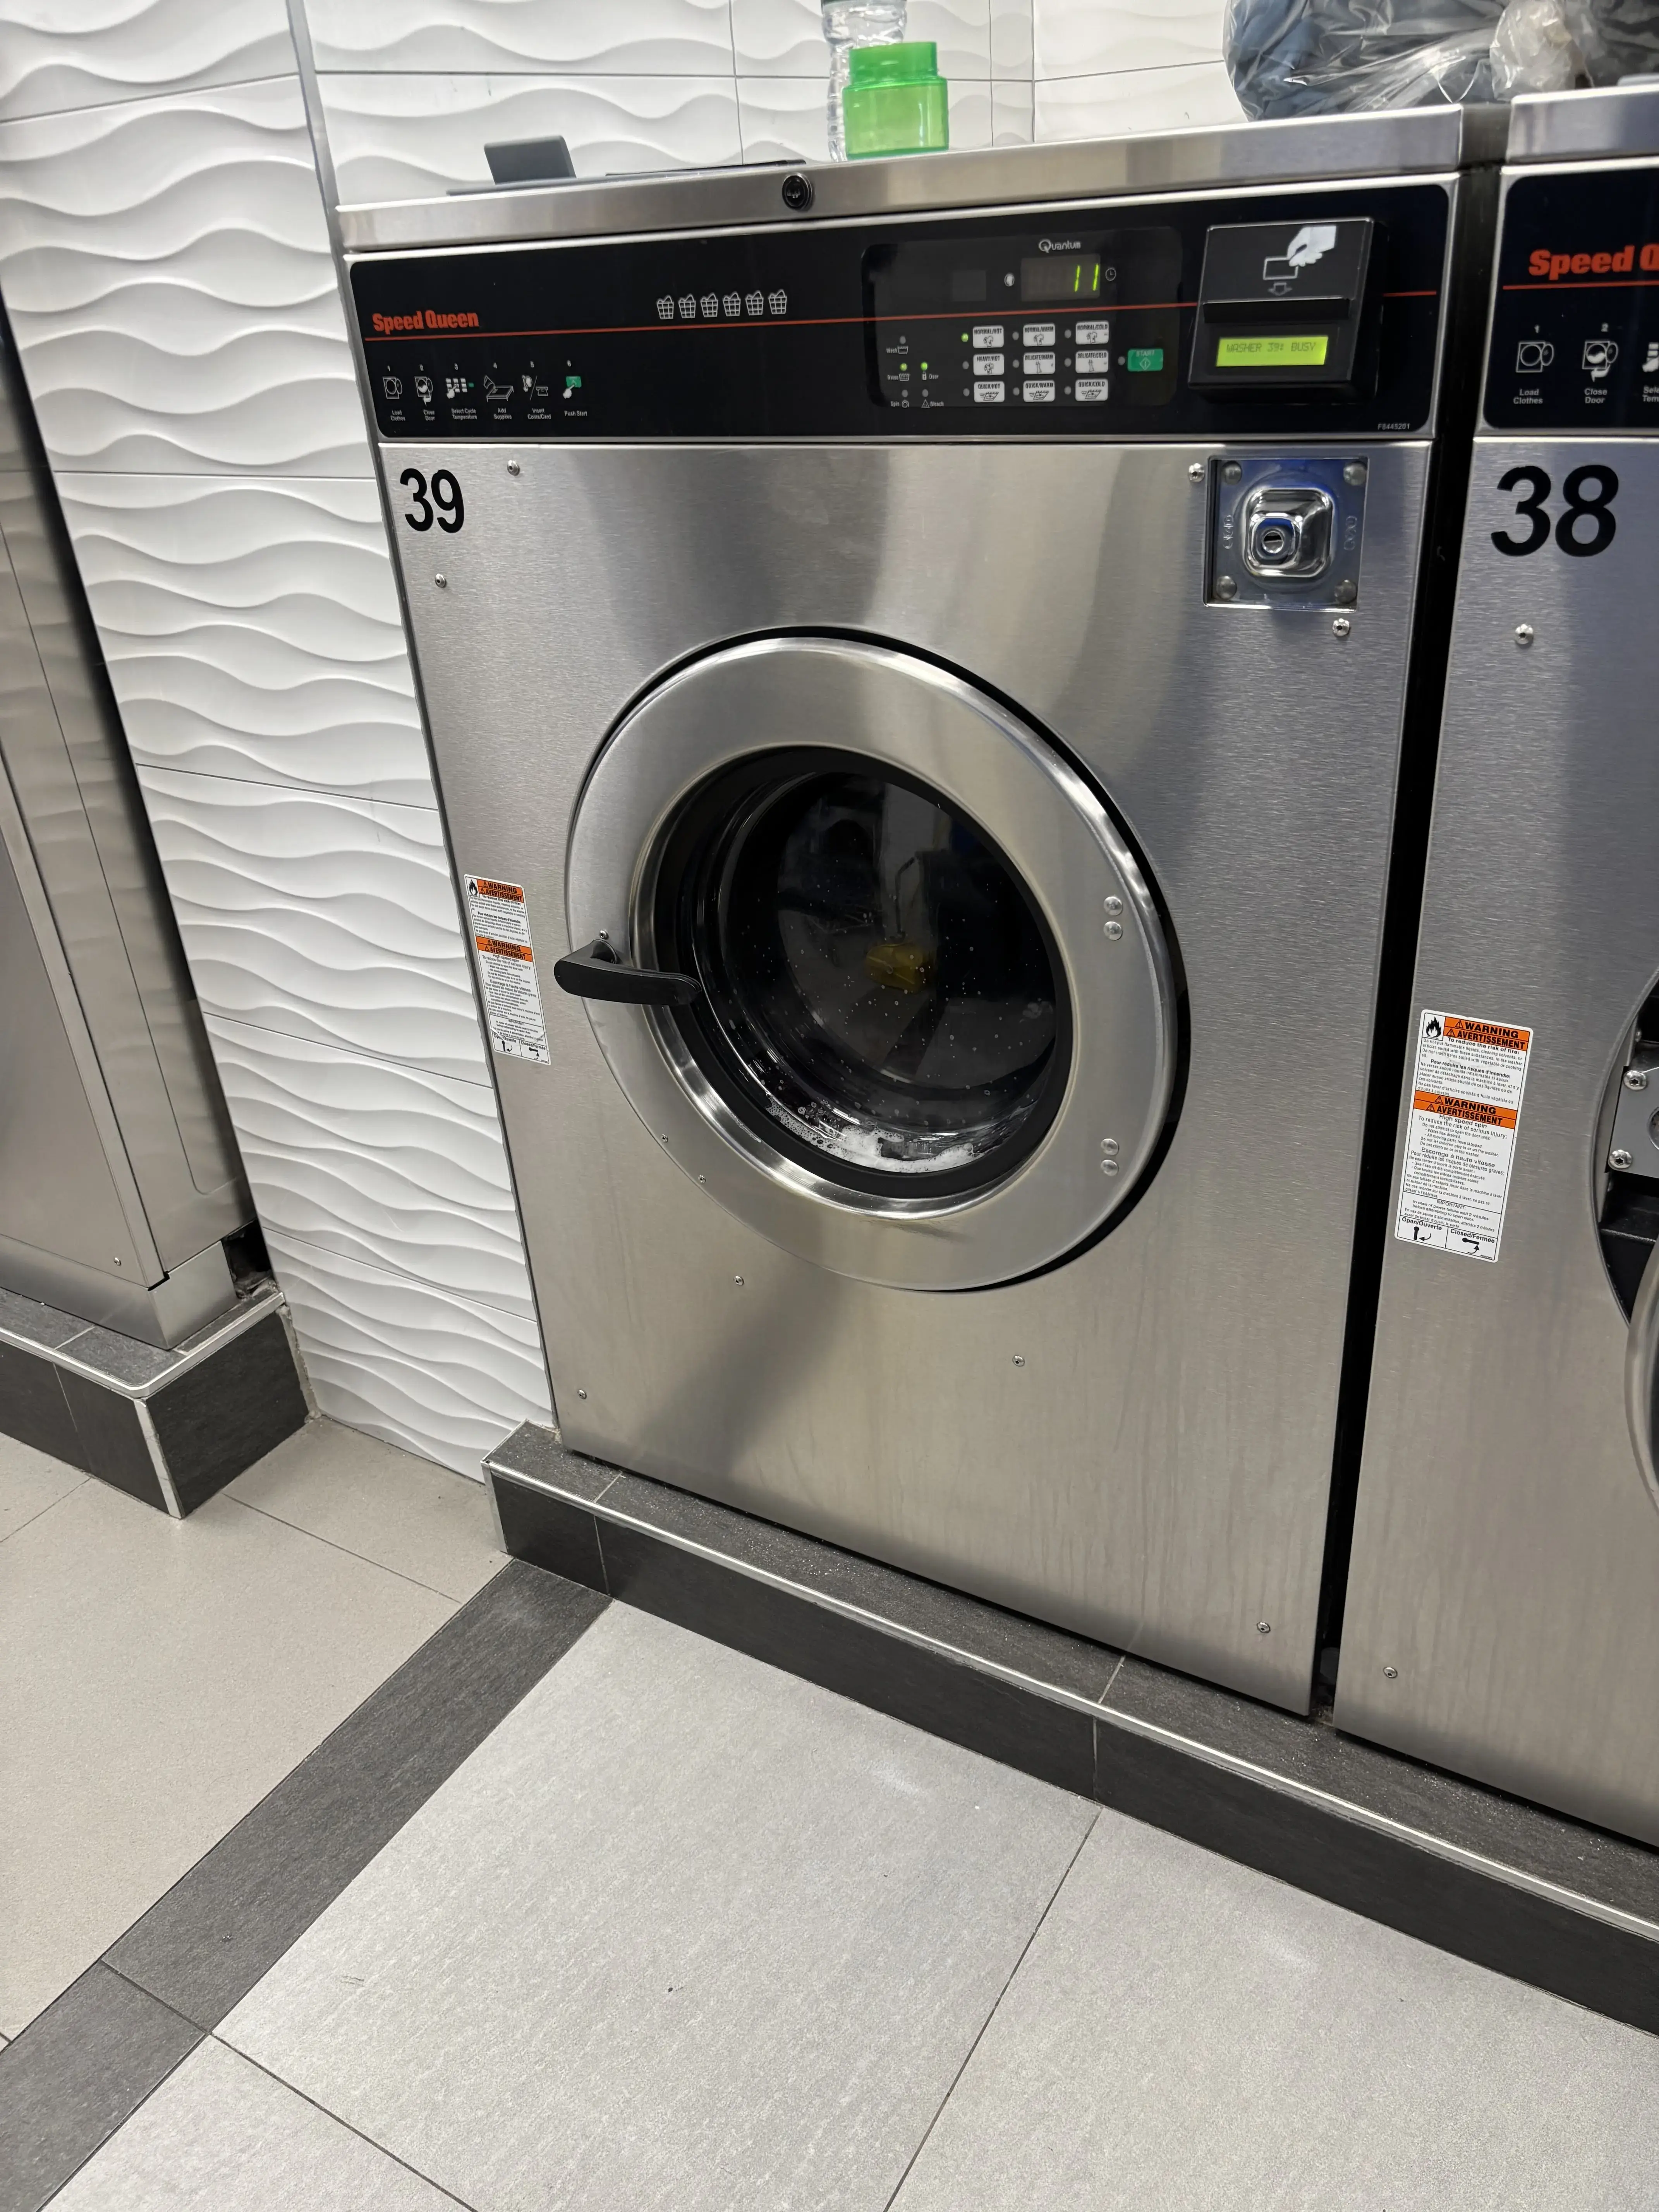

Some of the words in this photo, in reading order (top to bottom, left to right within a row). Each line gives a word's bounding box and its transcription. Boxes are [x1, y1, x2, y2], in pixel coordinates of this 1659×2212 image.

[1038, 239, 1081, 253] Quantum
[1528, 245, 1635, 280] Speed
[1074, 264, 1099, 292] 11
[373, 311, 424, 335] Speed
[425, 310, 479, 328] Queen
[1534, 325, 1540, 333] 1
[1601, 322, 1609, 332] 2
[1226, 343, 1262, 353] WASHER
[1291, 342, 1316, 352] BUSY
[400, 468, 465, 533] 39
[1491, 465, 1619, 558] 38
[485, 888, 522, 902] AVERTISSEMENT
[488, 882, 517, 893] WARNING
[489, 946, 526, 960] AVERTISSEMENT
[491, 940, 521, 952] WARNING
[1464, 1022, 1519, 1039] WARNING
[1456, 1030, 1525, 1050] AVERTISSEMENT
[1467, 1065, 1484, 1074] risques
[1485, 1069, 1510, 1079] d'incendie:
[1444, 1097, 1496, 1115] WARNING
[1436, 1104, 1503, 1126] AVERTISSEMENT
[1439, 1114, 1453, 1122] High
[1454, 1117, 1473, 1126] speed
[1474, 1121, 1487, 1129] spin
[1425, 1117, 1443, 1125] reduce
[1470, 1126, 1489, 1135] serious
[1421, 1147, 1449, 1158] Essorage
[1474, 1159, 1495, 1168] vitesse
[1401, 1216, 1442, 1231] Open/Ouverte
[1450, 1228, 1495, 1243] Closed/Fermée
